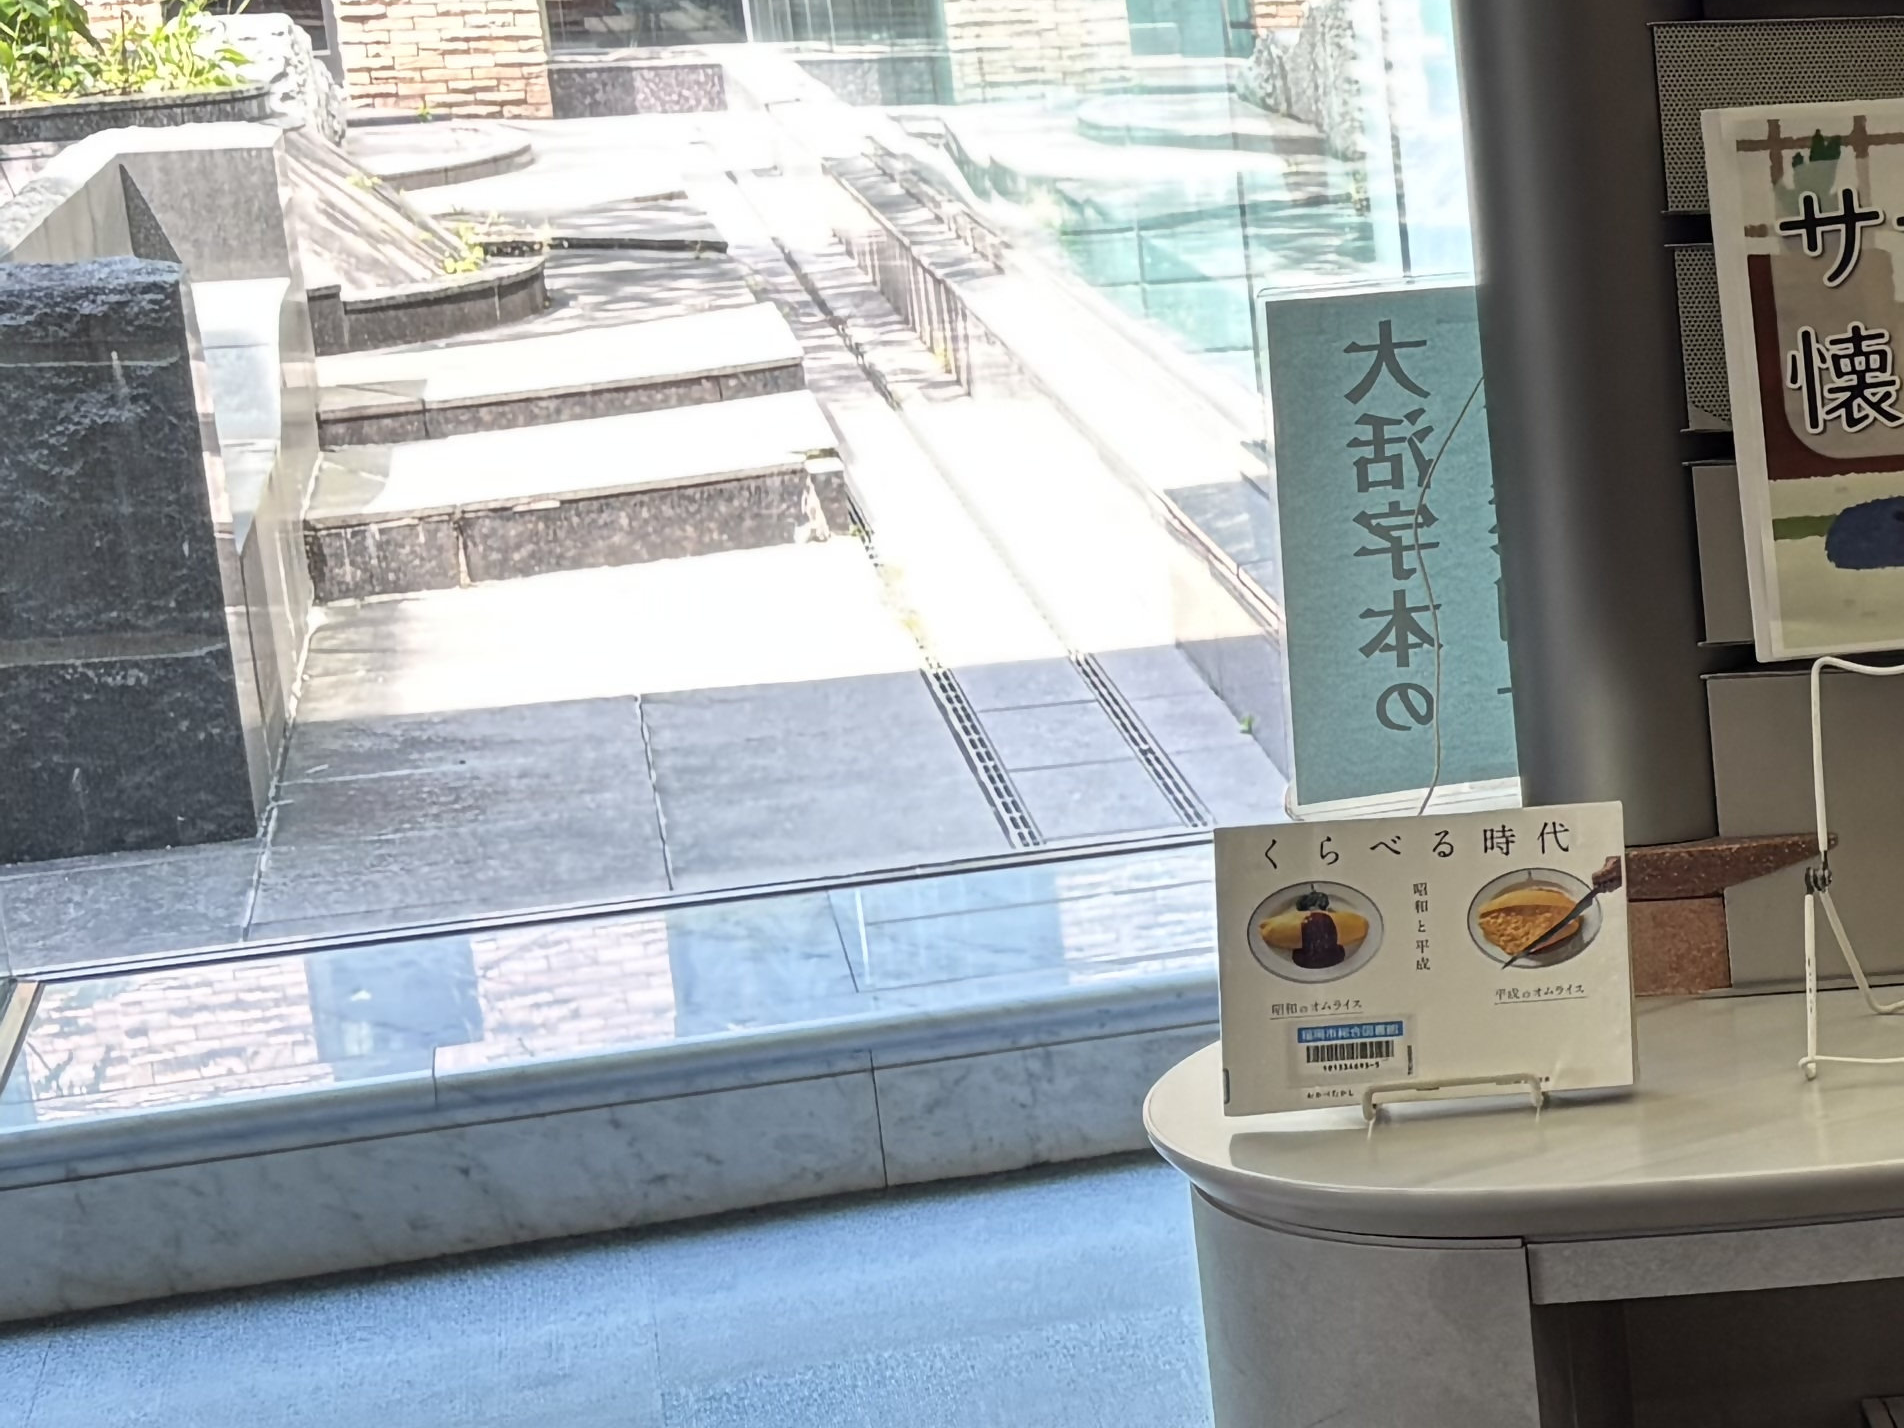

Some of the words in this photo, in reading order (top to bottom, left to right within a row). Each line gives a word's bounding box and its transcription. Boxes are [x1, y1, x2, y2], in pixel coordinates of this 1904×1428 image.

[1264, 821, 1570, 869] くらべる時代
[1413, 882, 1431, 971] 昭和と平成
[1271, 1000, 1362, 1016] 昭和のオムライス
